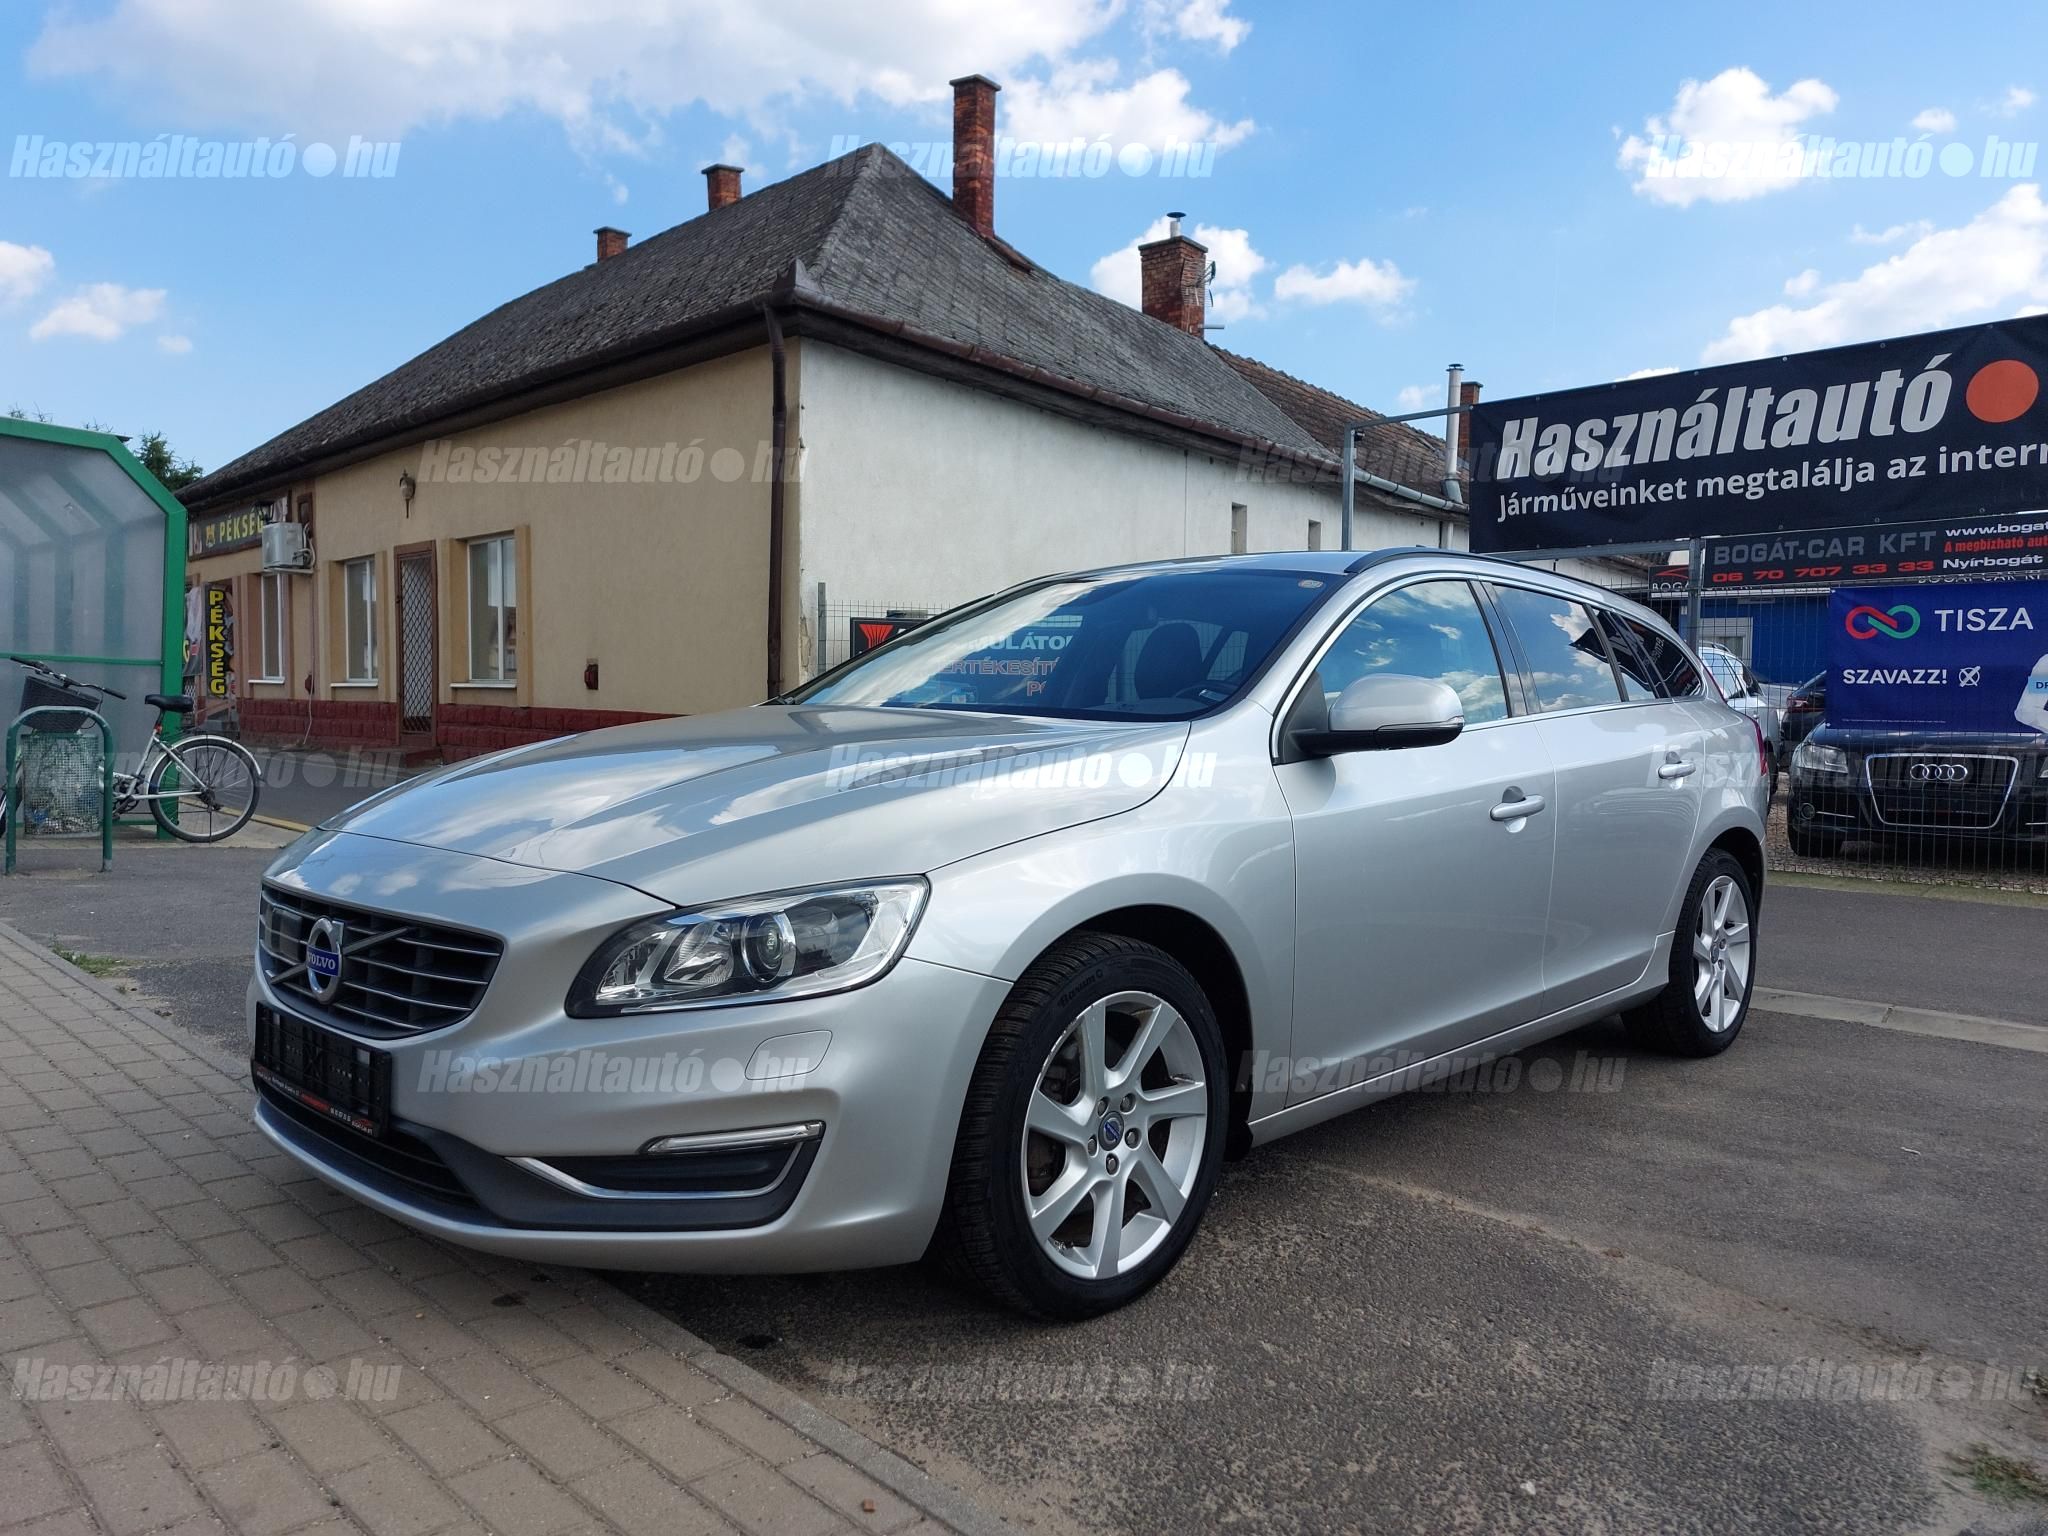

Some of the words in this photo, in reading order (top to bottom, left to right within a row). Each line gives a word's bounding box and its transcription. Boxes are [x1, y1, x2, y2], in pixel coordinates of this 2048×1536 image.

[1496, 353, 1952, 480] Használtautó
[1498, 476, 1687, 522] Járműveinket
[1697, 457, 1875, 500] megtalálja
[1887, 455, 1927, 480] az
[1714, 536, 1865, 565] BOGÁT-CAR
[1880, 530, 1937, 554] KFT
[1944, 541, 1952, 553] A
[1712, 572, 1744, 583] 06
[1753, 569, 1785, 580] 70
[1794, 565, 1842, 578] 707
[1852, 563, 1887, 575] 33
[1898, 560, 1935, 572] 33
[1943, 554, 2044, 569] Nyírbogát
[1934, 607, 2033, 632] TISZA
[209, 590, 226, 695] PÉKSÉG
[1843, 669, 1947, 685] SZAVAZZ!
[307, 951, 336, 970] VOLVO
